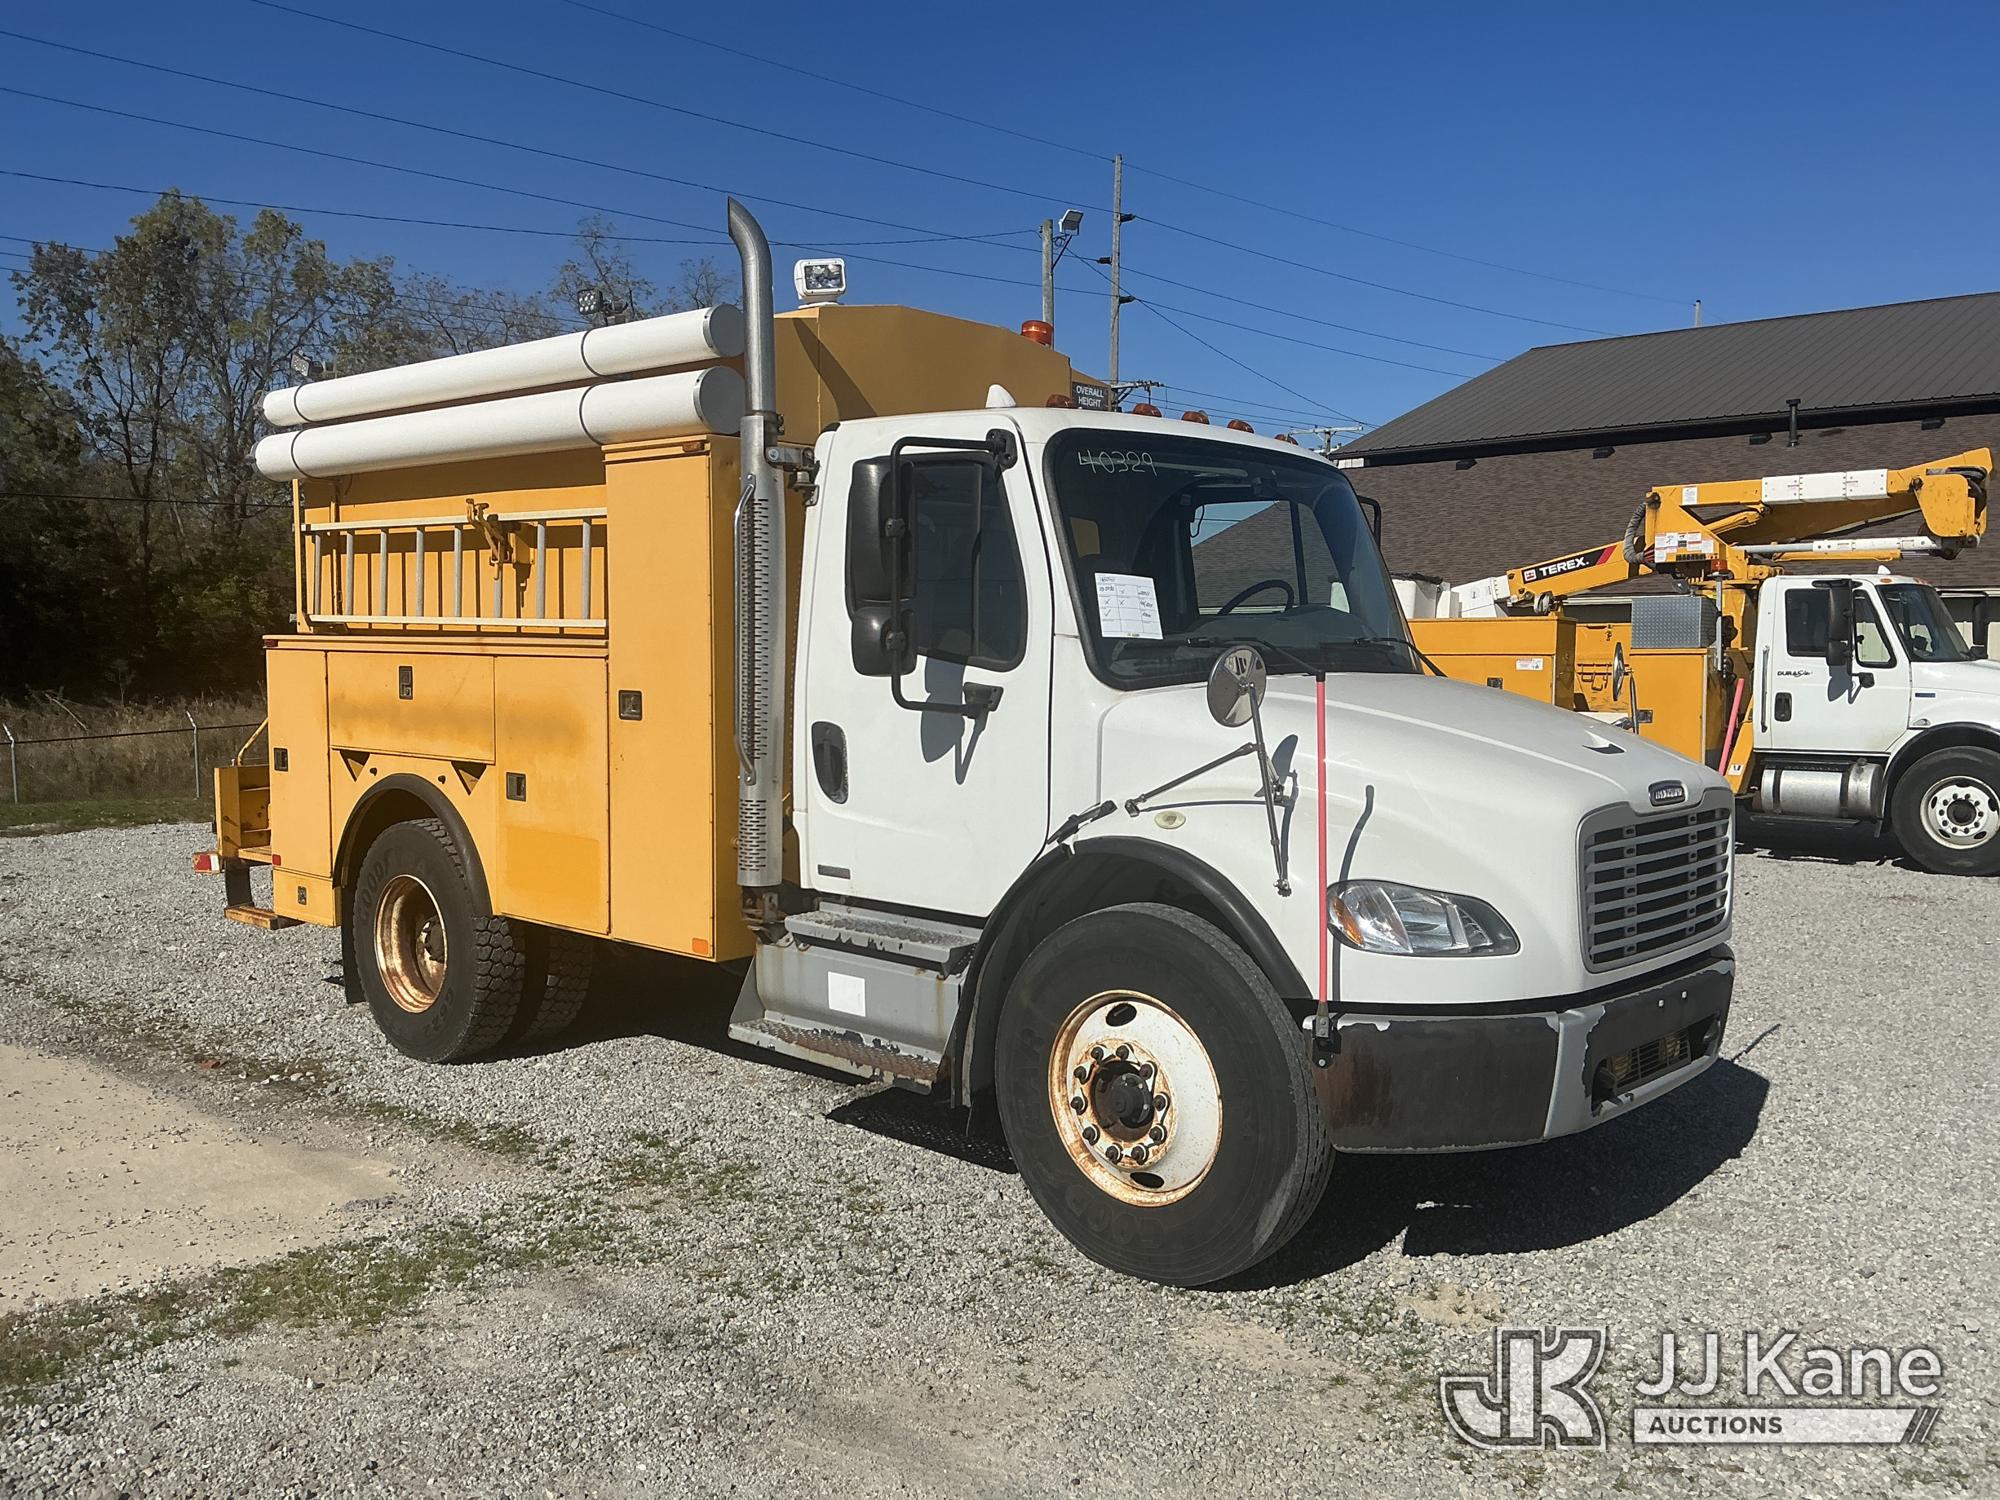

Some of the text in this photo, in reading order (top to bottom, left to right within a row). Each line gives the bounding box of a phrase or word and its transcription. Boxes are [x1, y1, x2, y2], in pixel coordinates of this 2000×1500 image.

[1076, 385, 1104, 398] OVERALL
[1078, 396, 1101, 408] HEIGHT
[1078, 449, 1157, 476] 40329
[1539, 556, 1586, 577] TEREX
